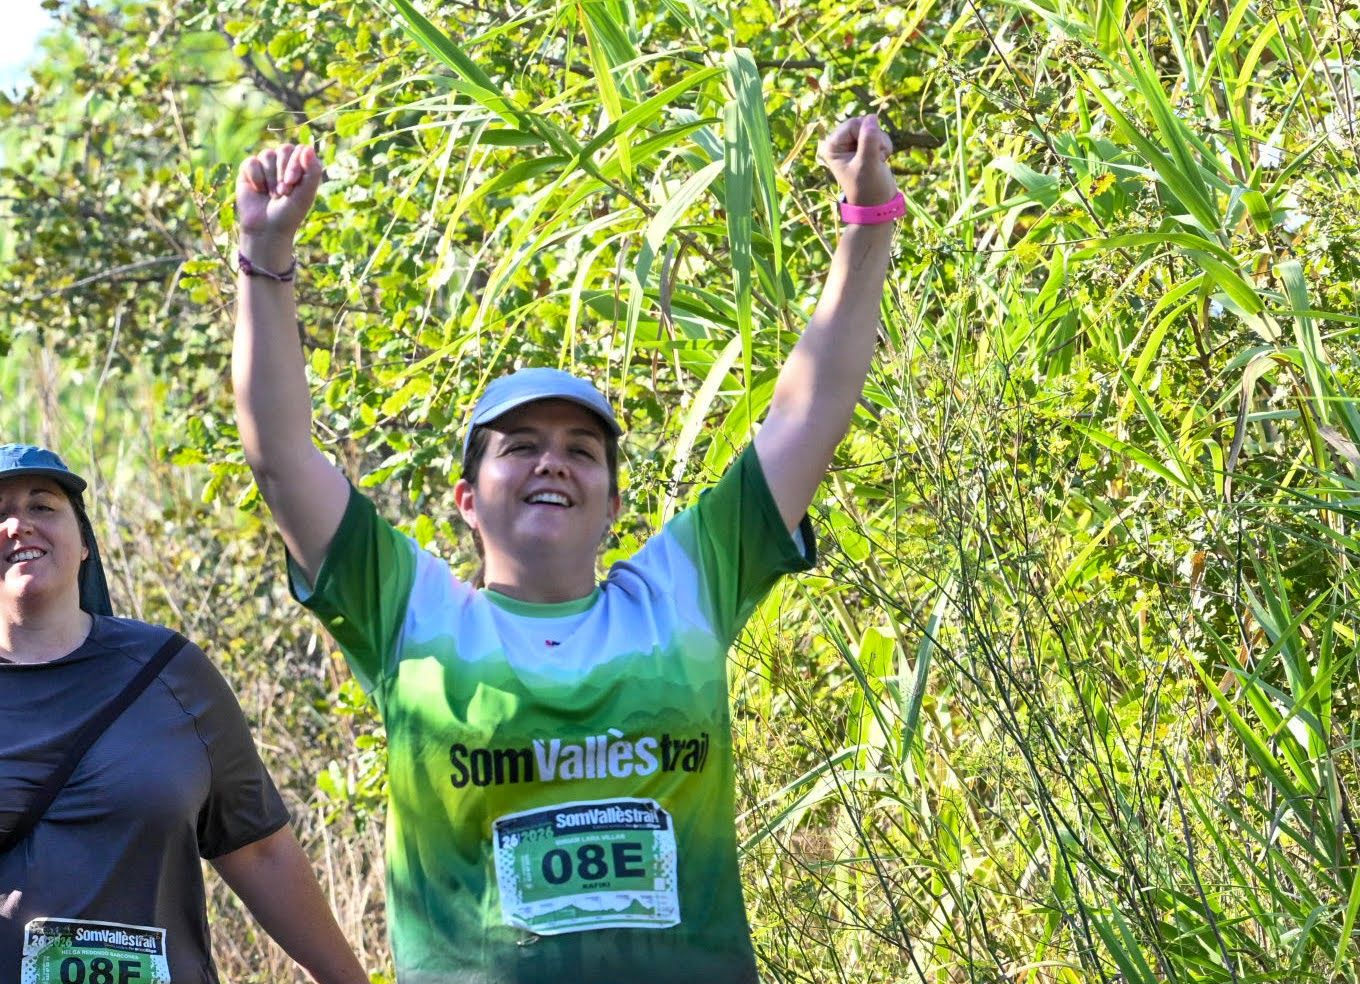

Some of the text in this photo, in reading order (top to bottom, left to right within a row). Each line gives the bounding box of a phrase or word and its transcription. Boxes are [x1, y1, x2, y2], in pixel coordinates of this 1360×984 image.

[556, 806, 659, 828] SomVallèstrail
[542, 842, 646, 885] 08E
[75, 927, 156, 949] SomVallèstrail
